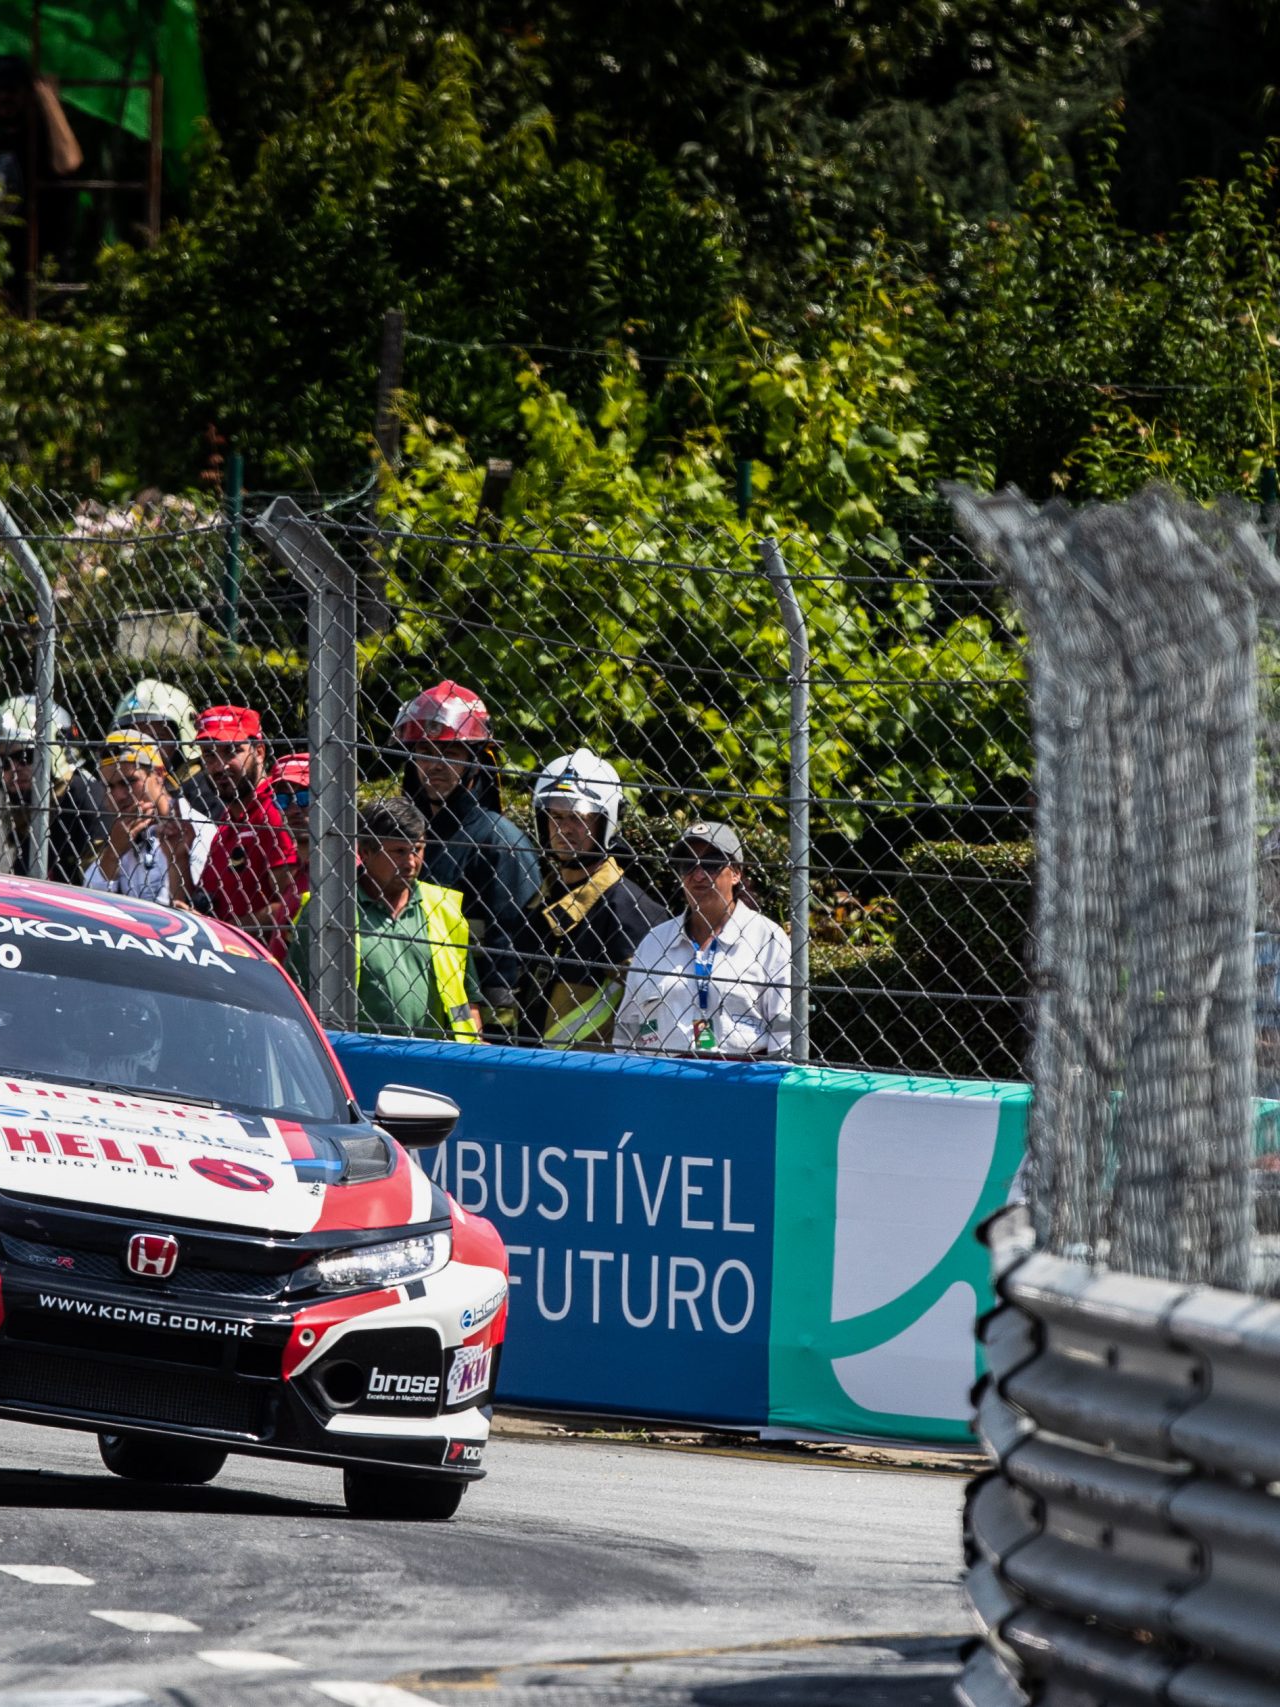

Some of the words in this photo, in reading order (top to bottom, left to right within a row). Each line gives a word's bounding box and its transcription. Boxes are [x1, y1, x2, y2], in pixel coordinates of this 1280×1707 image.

[0, 1125, 177, 1170] HELL
[10, 1155, 98, 1168] ENERGY
[111, 1165, 179, 1181] DRINK
[505, 1245, 756, 1334] FUTURO
[39, 1293, 254, 1338] WWW.KCMG.COM.HK
[369, 1367, 440, 1394] brose
[458, 1351, 491, 1393] KW
[366, 1393, 395, 1401] Excellence
